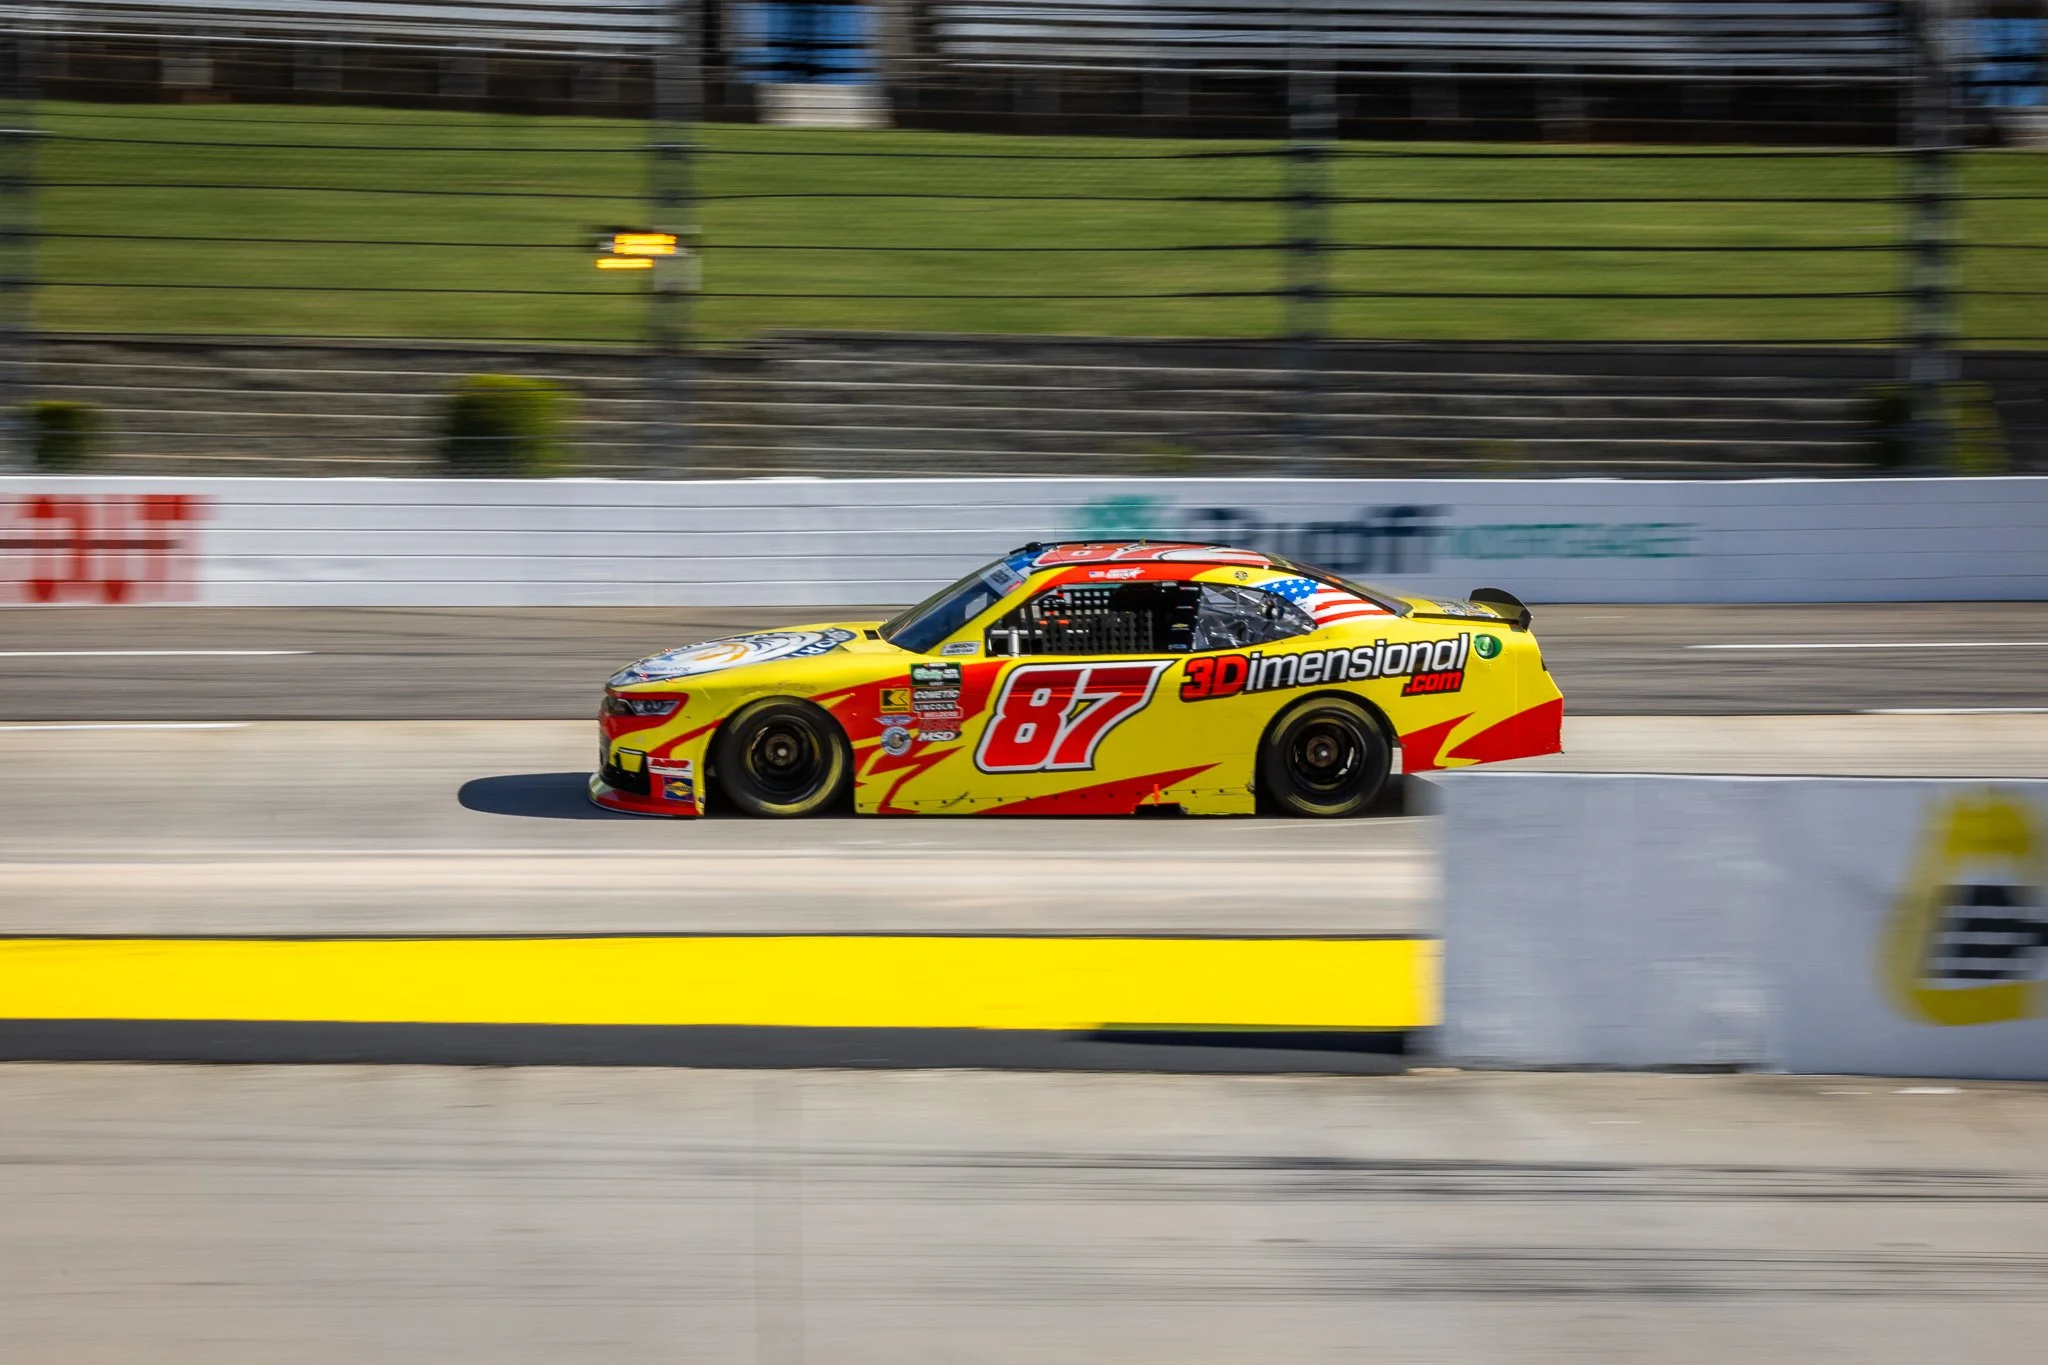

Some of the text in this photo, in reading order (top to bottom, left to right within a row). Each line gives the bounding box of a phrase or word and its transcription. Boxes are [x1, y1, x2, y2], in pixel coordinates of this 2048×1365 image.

[1181, 633, 1470, 701] 3Dimensional
[1402, 672, 1463, 696] .com
[913, 690, 960, 699] COMETIC
[914, 702, 954, 711] LINCOLN
[975, 660, 1178, 773] 87
[918, 732, 956, 741] MSD
